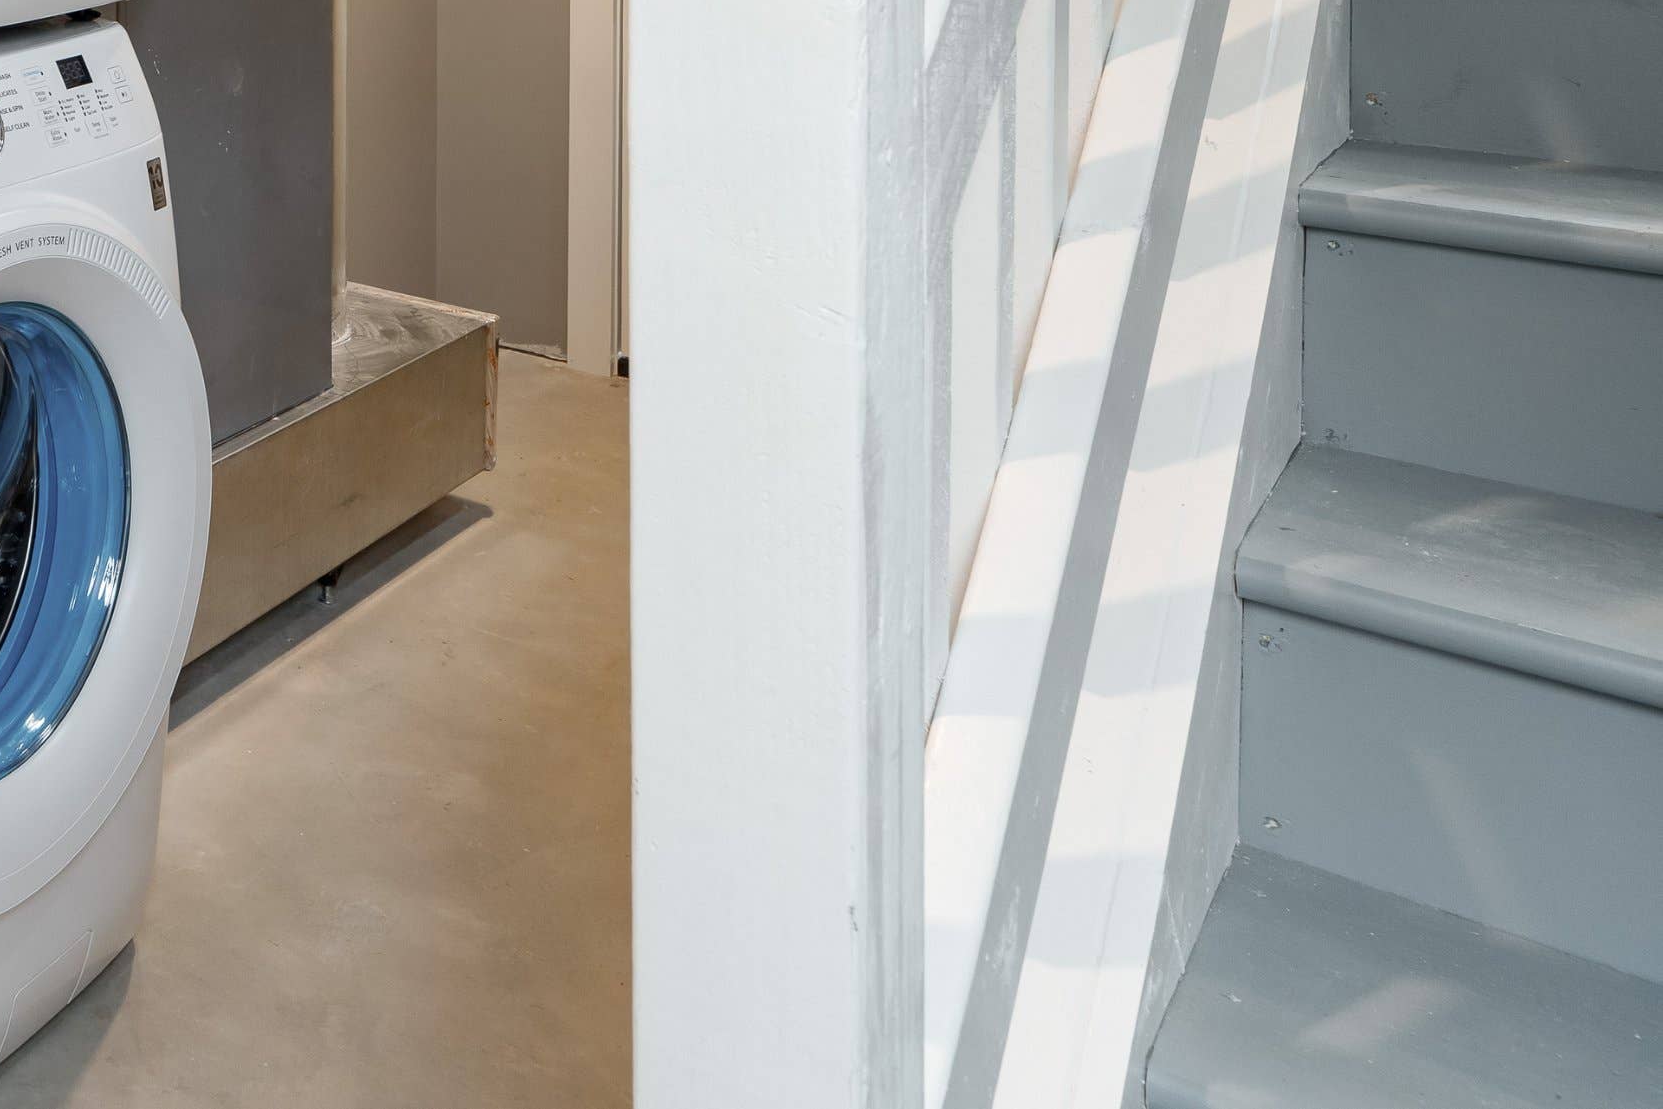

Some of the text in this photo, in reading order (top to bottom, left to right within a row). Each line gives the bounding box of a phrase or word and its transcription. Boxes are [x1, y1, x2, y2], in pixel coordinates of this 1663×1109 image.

[14, 122, 30, 130] CLEAN
[15, 238, 34, 250] VENT
[38, 236, 65, 246] SYSTEM
